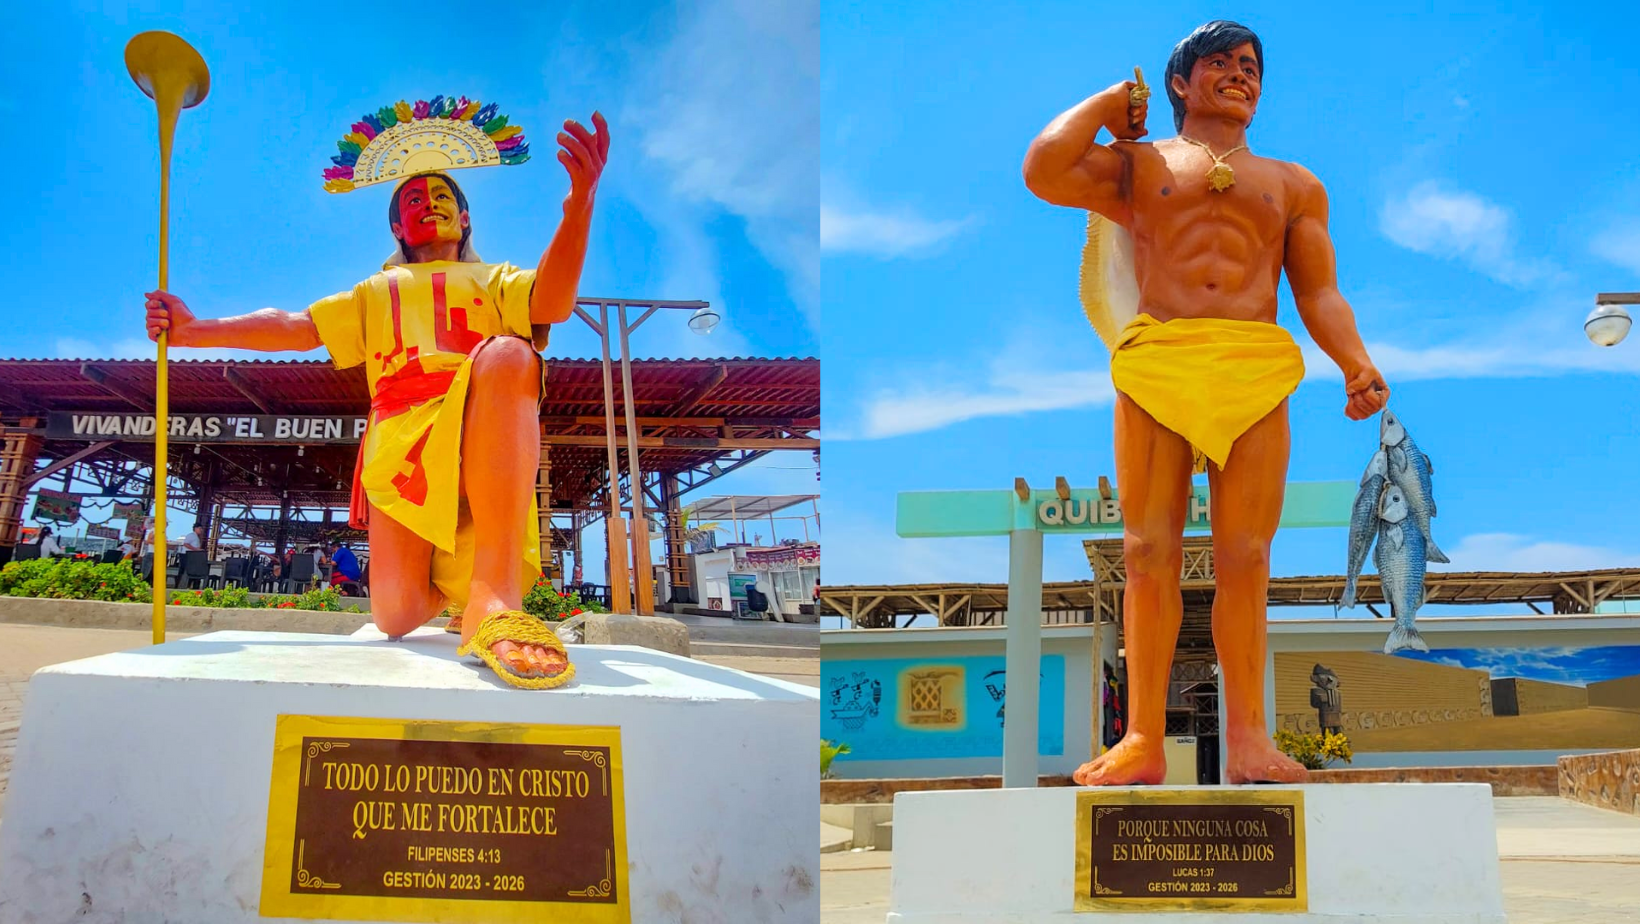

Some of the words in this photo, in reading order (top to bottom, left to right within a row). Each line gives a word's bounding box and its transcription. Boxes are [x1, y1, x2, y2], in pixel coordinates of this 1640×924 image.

[275, 418, 342, 439] BUEN
[323, 763, 379, 791] TODO
[384, 765, 410, 792] LO
[415, 766, 482, 794] PUEDO
[488, 769, 513, 795] EN
[520, 769, 589, 797] CRISTO
[353, 801, 395, 839] QUE
[401, 803, 432, 831] ME
[438, 804, 557, 834] FORTALECE
[1118, 821, 1169, 843] PORQUE
[1173, 820, 1231, 837] NINGUNA
[1236, 820, 1268, 837] COSA
[408, 846, 474, 862] FILIPENSES
[478, 849, 500, 863] 4:13
[1113, 845, 1127, 860] ES
[1131, 844, 1201, 860] IMPOSIBLE
[1205, 844, 1239, 860] PARA
[1242, 845, 1274, 861] DIOS
[384, 869, 445, 888] GESTIÓN
[450, 874, 481, 889] 2023
[494, 875, 524, 890] 2026
[1173, 868, 1198, 876] LUCAS
[1200, 868, 1214, 876] 1:37
[1149, 881, 1187, 891] GESTIÓN
[1191, 883, 1210, 892] 2023
[1218, 883, 1238, 892] 2026
